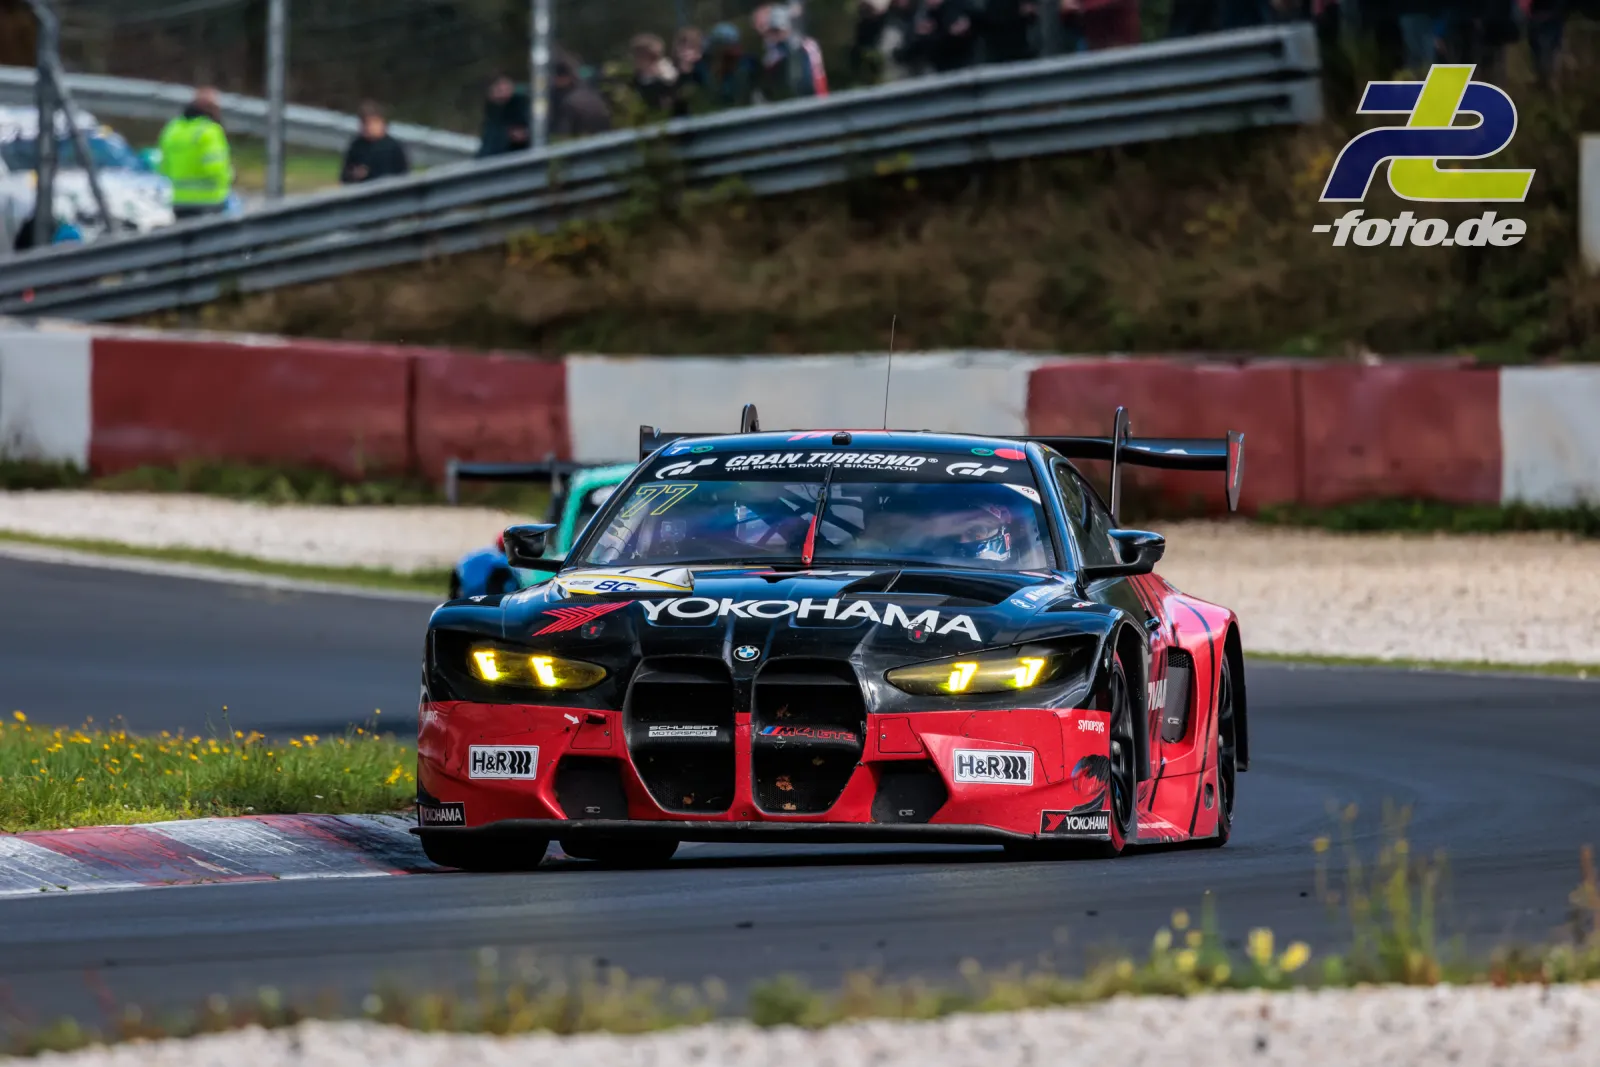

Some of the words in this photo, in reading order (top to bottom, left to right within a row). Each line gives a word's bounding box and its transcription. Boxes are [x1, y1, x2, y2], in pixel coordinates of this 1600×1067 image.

[725, 453, 804, 467] GRAN
[843, 463, 918, 472] SIMULATOR
[621, 484, 699, 518] 77
[639, 597, 983, 643] YOKOHAMA
[472, 750, 510, 774] H&R
[957, 754, 1005, 779] H&R
[1066, 814, 1109, 832] YOKOHAMA
